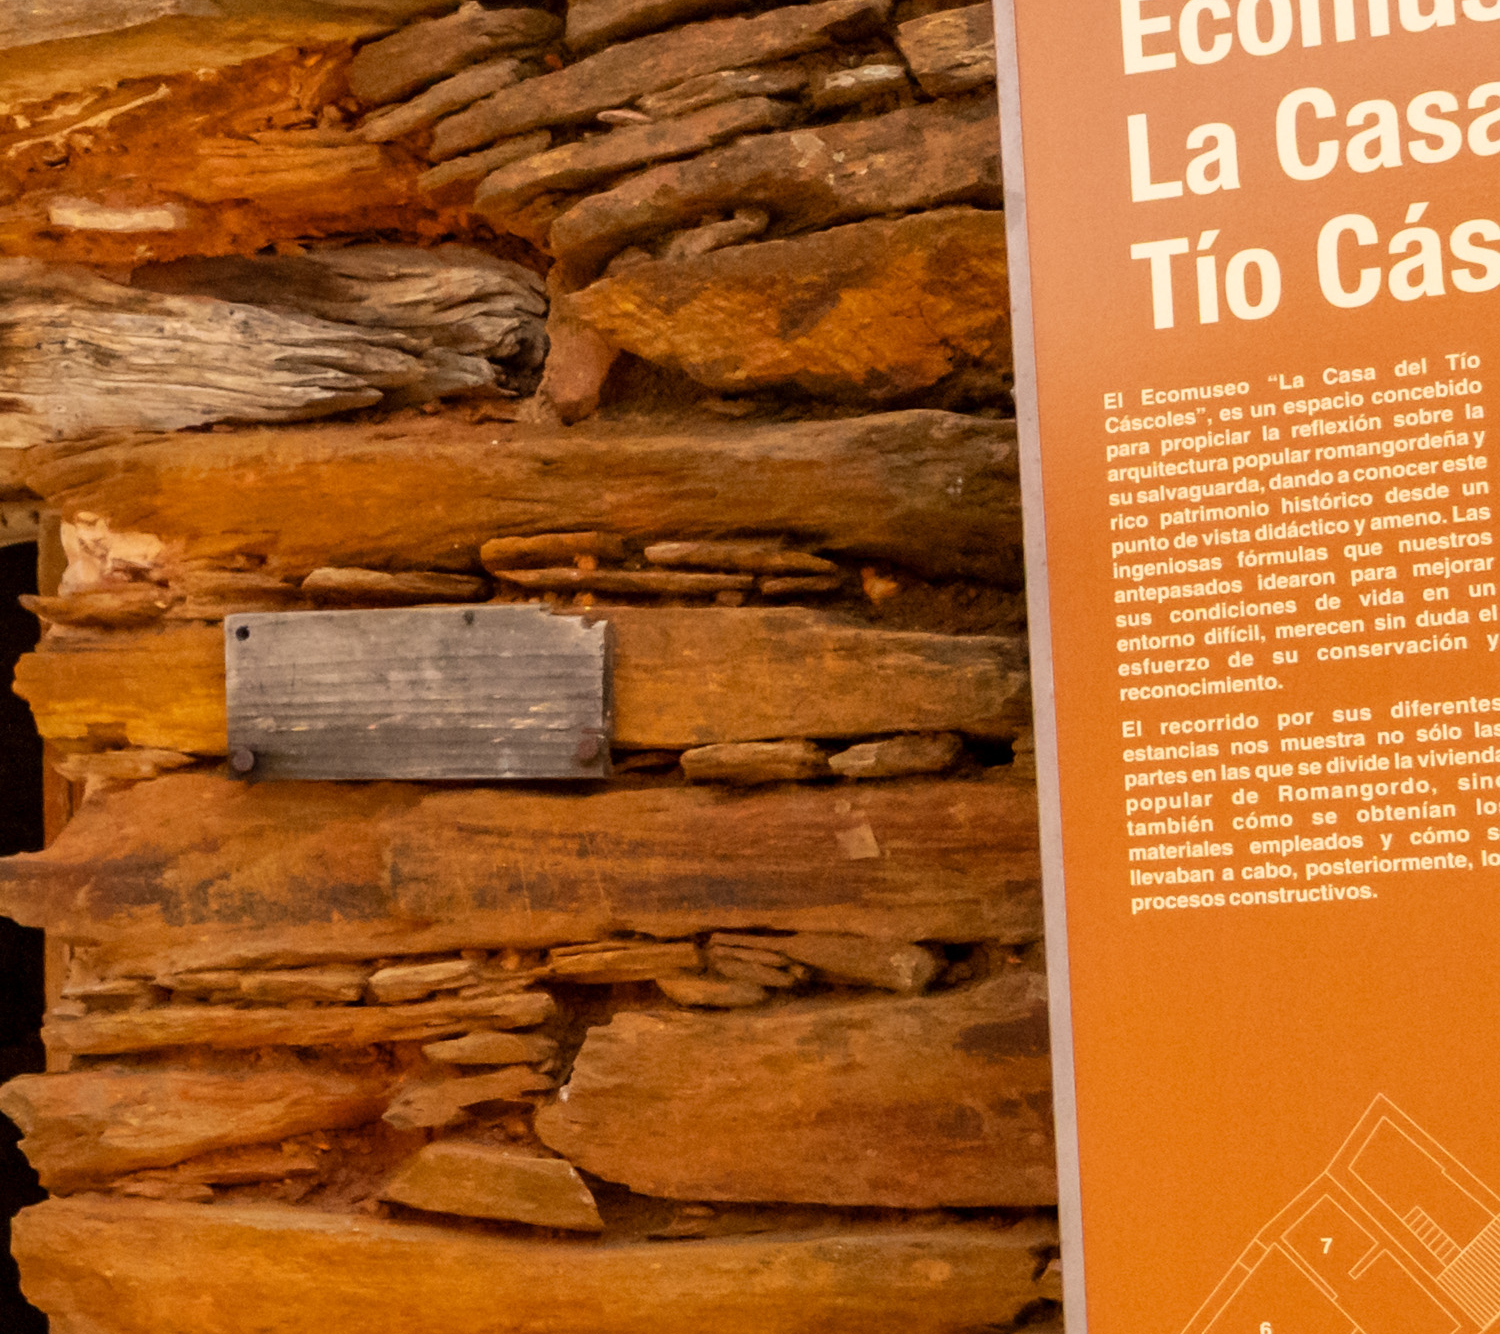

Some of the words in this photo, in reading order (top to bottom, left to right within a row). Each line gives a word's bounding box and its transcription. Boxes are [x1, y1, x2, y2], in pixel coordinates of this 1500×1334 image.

[1128, 114, 1240, 202] La
[1131, 230, 1281, 329] Tío
[1103, 391, 1124, 411] El
[1140, 381, 1250, 406] Ecomuseo
[1267, 373, 1305, 391] “La
[1322, 367, 1376, 386] Casa
[1394, 357, 1427, 378] del
[1444, 351, 1481, 371] Tío
[1104, 406, 1213, 434] Cáscoles”,
[1218, 406, 1244, 422] es
[1250, 403, 1277, 419] un
[1283, 391, 1364, 417] espacio
[1371, 377, 1483, 405] concebido
[1106, 441, 1151, 463] para
[1160, 428, 1252, 457] propiciar
[1262, 425, 1281, 442] la
[1291, 413, 1382, 439] reflexión
[1393, 408, 1454, 428] sobre
[1465, 403, 1485, 420] la
[1107, 457, 1229, 484] arquitectura
[1232, 447, 1312, 474] popular
[1315, 430, 1470, 461] romangordeña
[1472, 430, 1486, 449] y
[1108, 492, 1133, 507] su
[1136, 476, 1265, 504] salvaguarda,
[1268, 468, 1334, 491] dando
[1337, 469, 1350, 484] a
[1352, 461, 1440, 482] conocer
[1441, 454, 1488, 473] este
[1110, 513, 1150, 531] rico
[1159, 500, 1270, 530] patrimonio
[1281, 491, 1374, 515] histórico
[1384, 482, 1450, 504] desde
[1462, 481, 1490, 497] un
[1121, 720, 1143, 739] El
[1160, 712, 1260, 736] recorrido
[1277, 711, 1314, 731] por
[1332, 707, 1373, 723] sus
[1122, 741, 1220, 763] estancias
[1230, 739, 1270, 756] nos
[1280, 731, 1366, 752] muestra
[1377, 730, 1405, 746] no
[1416, 723, 1463, 743] sólo
[1321, 1238, 1332, 1253] 7
